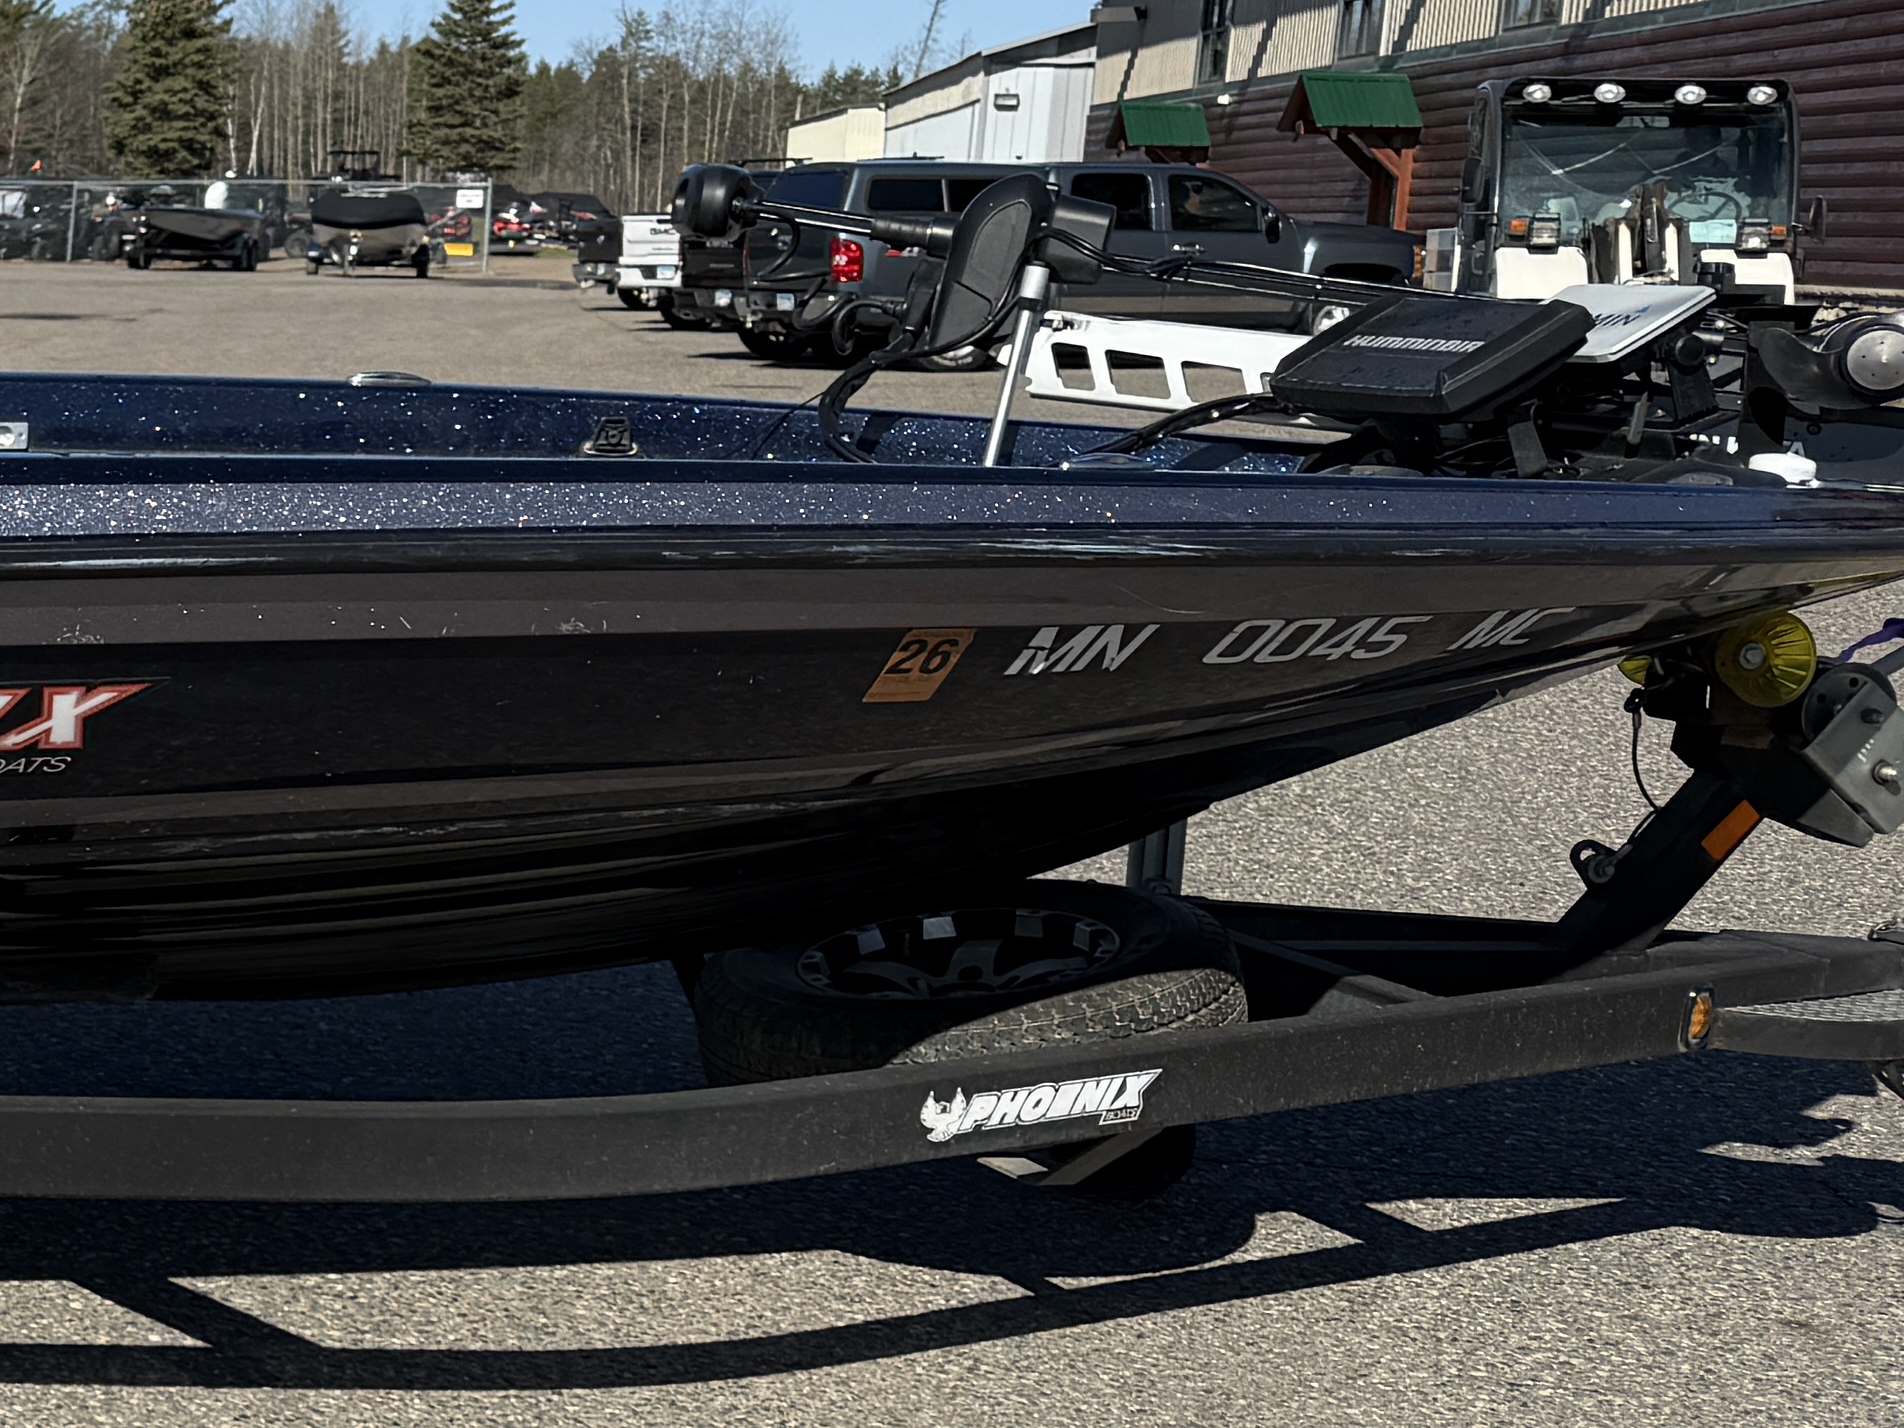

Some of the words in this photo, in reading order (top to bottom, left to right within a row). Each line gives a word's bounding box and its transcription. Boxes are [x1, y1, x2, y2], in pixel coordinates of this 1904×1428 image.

[1343, 335, 1486, 353] HUMMINBIR
[884, 638, 960, 675] 26
[1003, 624, 1161, 675] MN
[1201, 615, 1434, 665] 0045
[1447, 606, 1577, 651] MC
